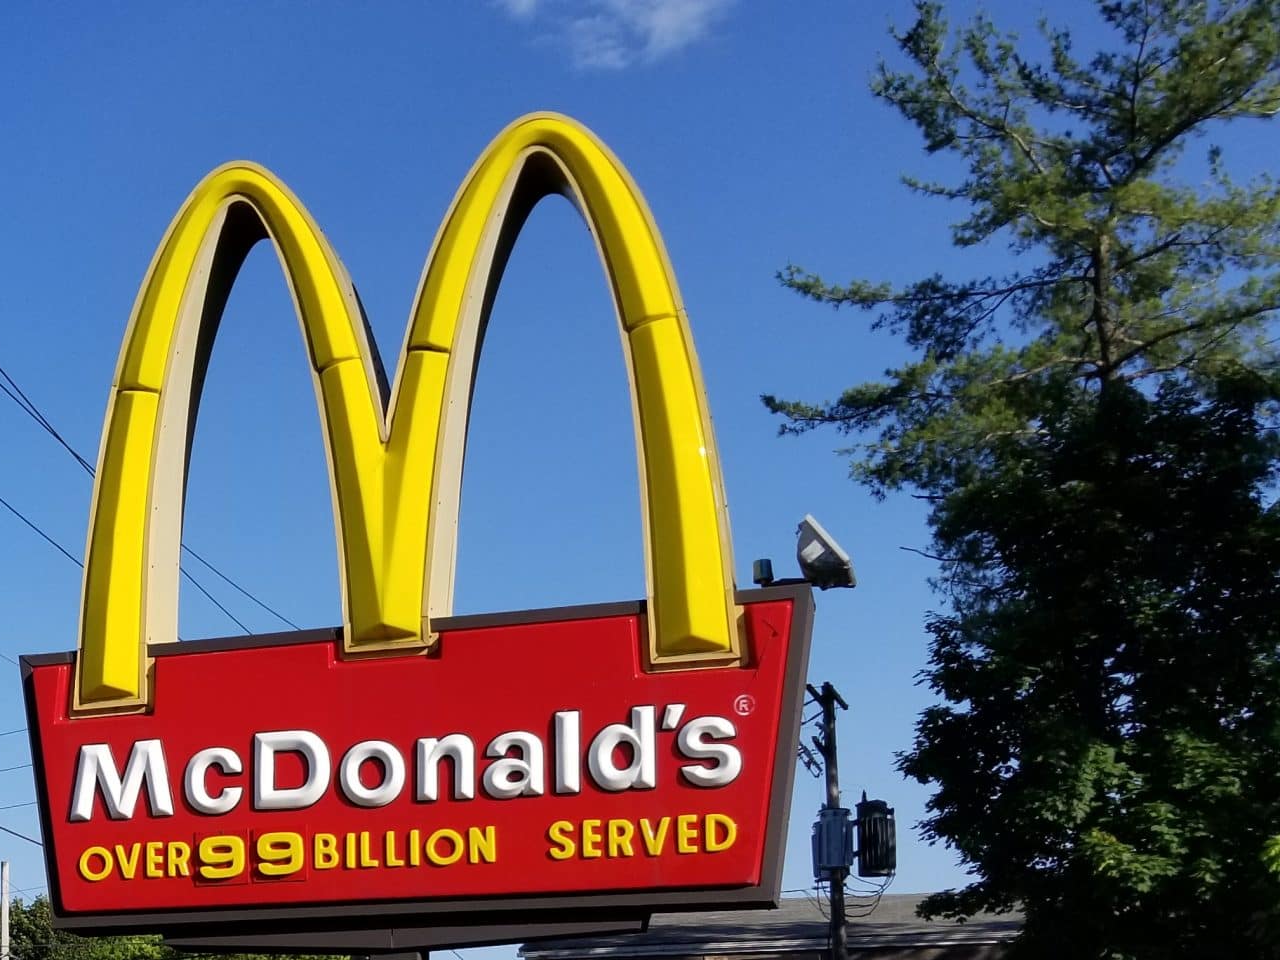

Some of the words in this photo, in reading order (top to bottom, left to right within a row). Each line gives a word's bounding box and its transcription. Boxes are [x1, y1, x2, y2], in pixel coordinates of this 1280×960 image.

[70, 704, 743, 822] McDonald's
[79, 840, 190, 881] OVER
[198, 831, 304, 879] 99
[314, 825, 497, 869] BILLION
[547, 813, 738, 861] SERVED
